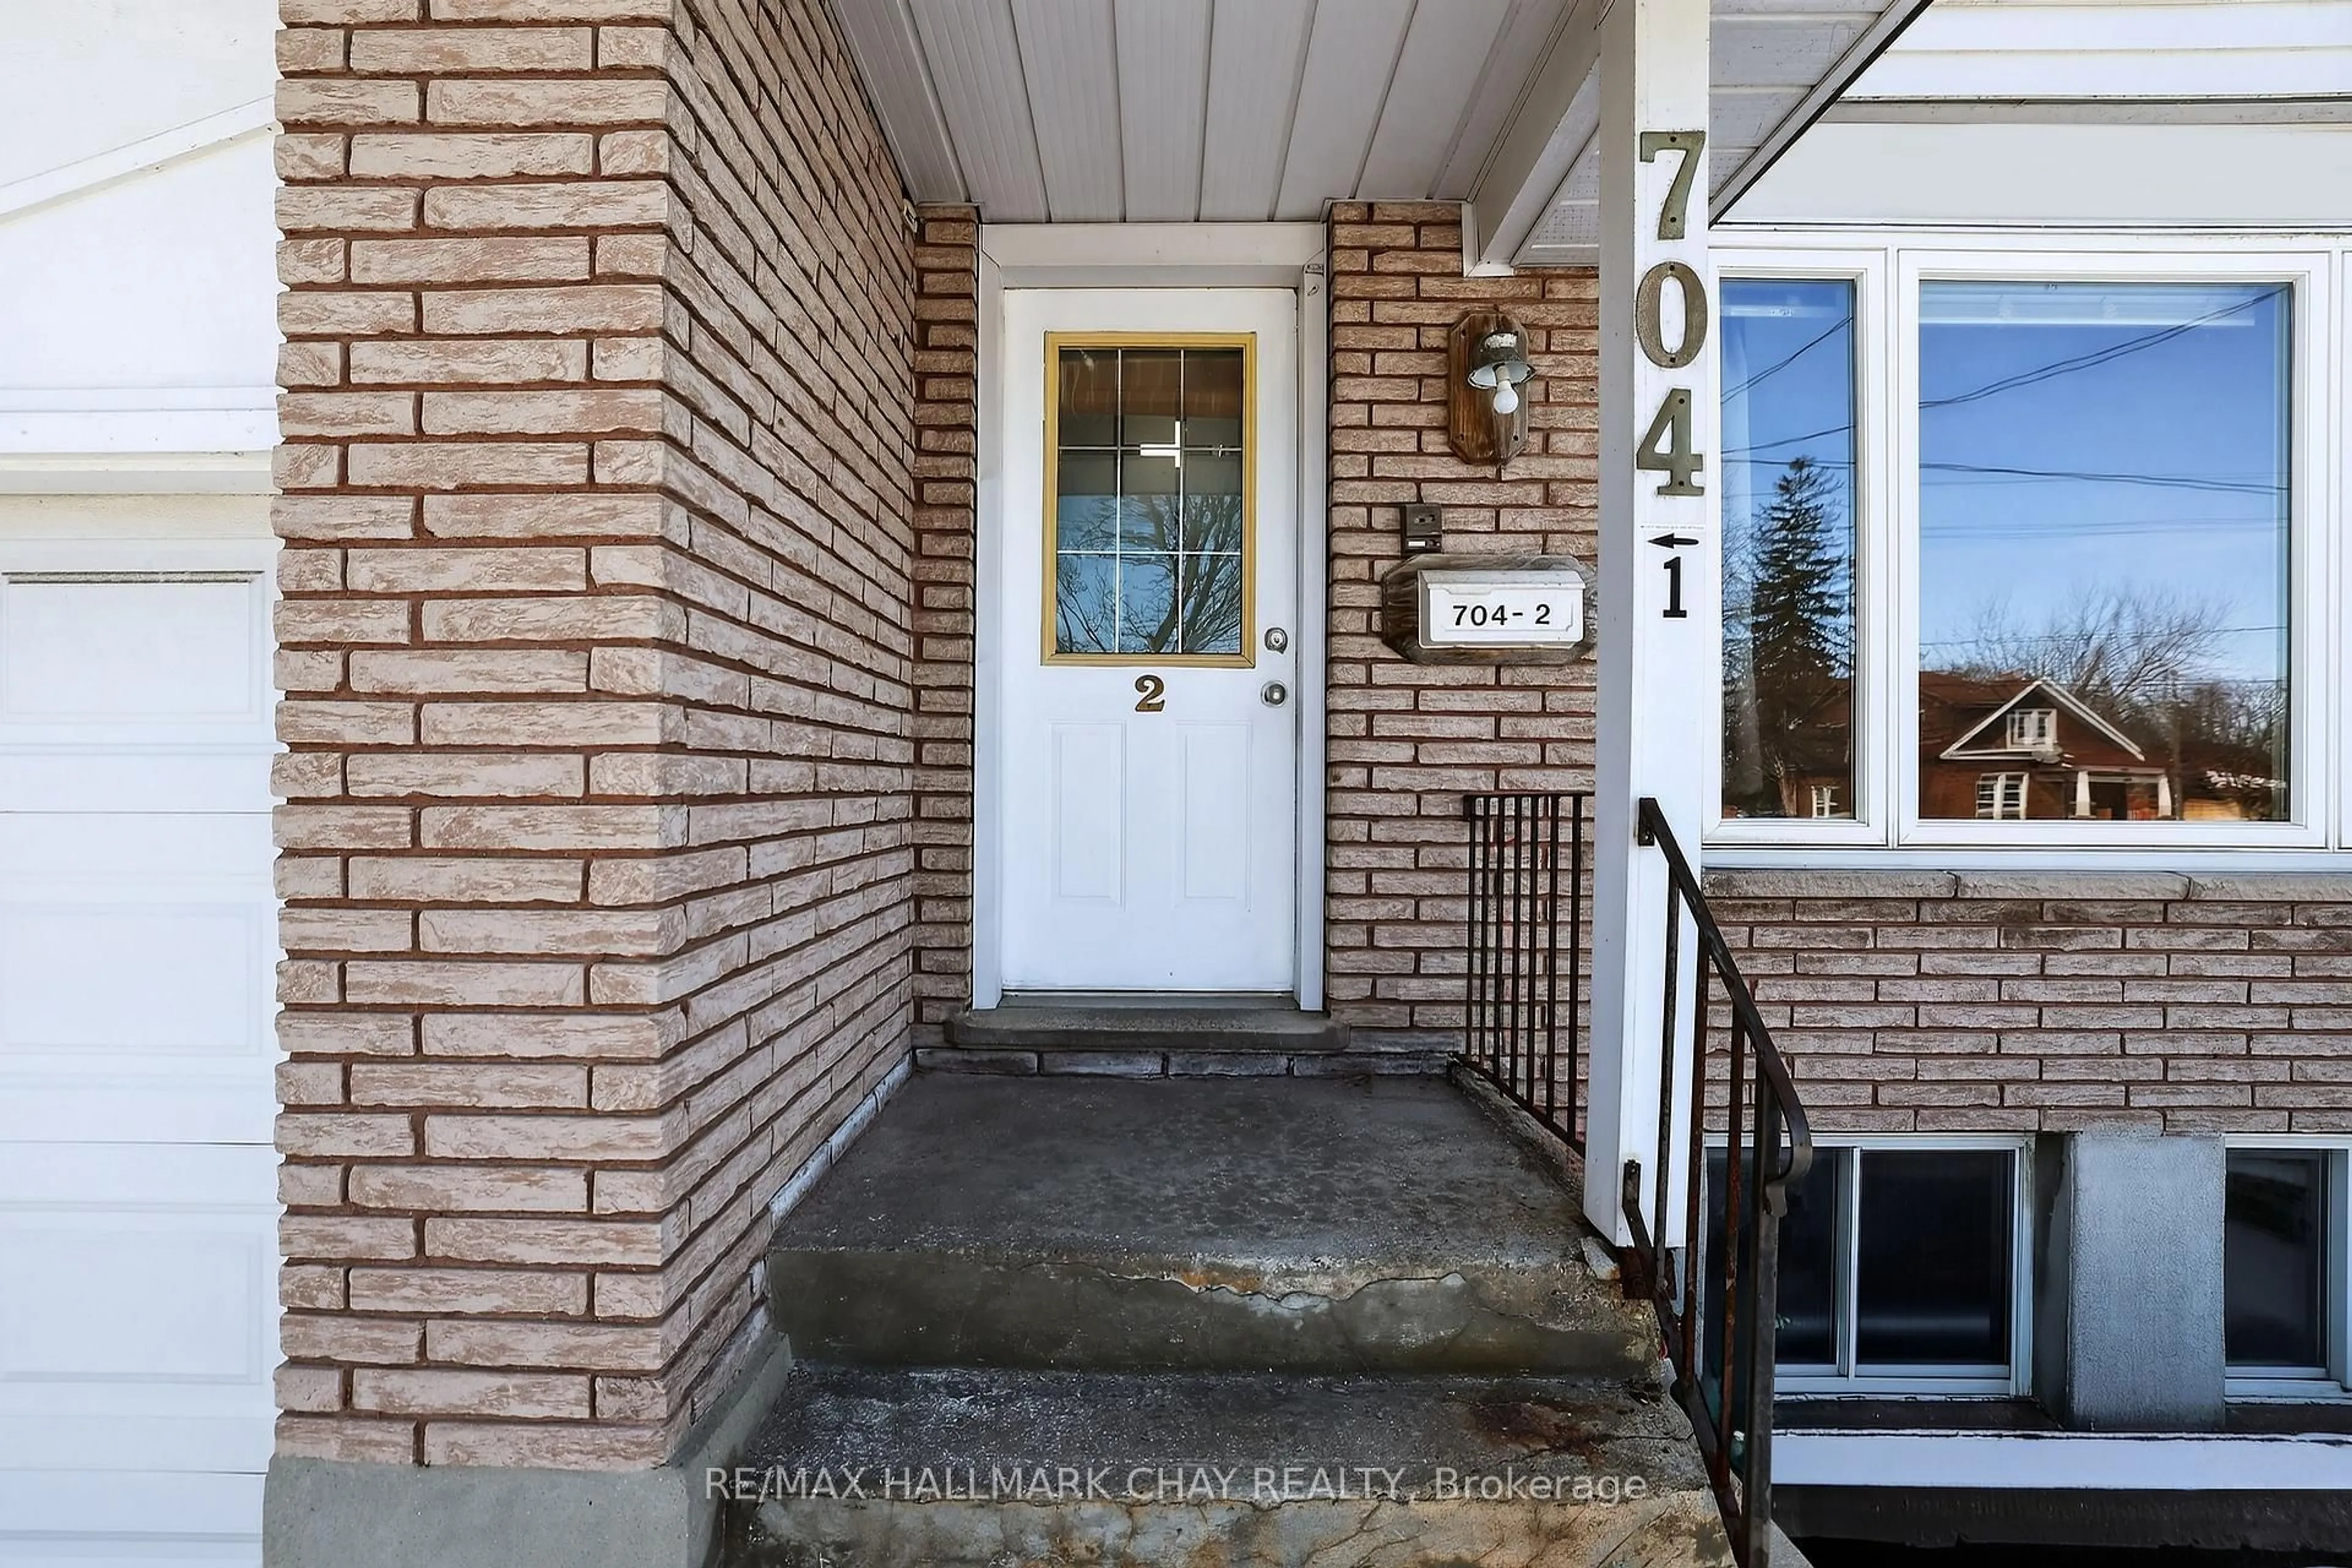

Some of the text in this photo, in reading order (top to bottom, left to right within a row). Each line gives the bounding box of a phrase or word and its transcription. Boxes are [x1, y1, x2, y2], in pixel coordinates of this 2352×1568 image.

[1635, 131, 1708, 496] 704
[1663, 556, 1687, 618] 1
[1135, 674, 1166, 712] 2
